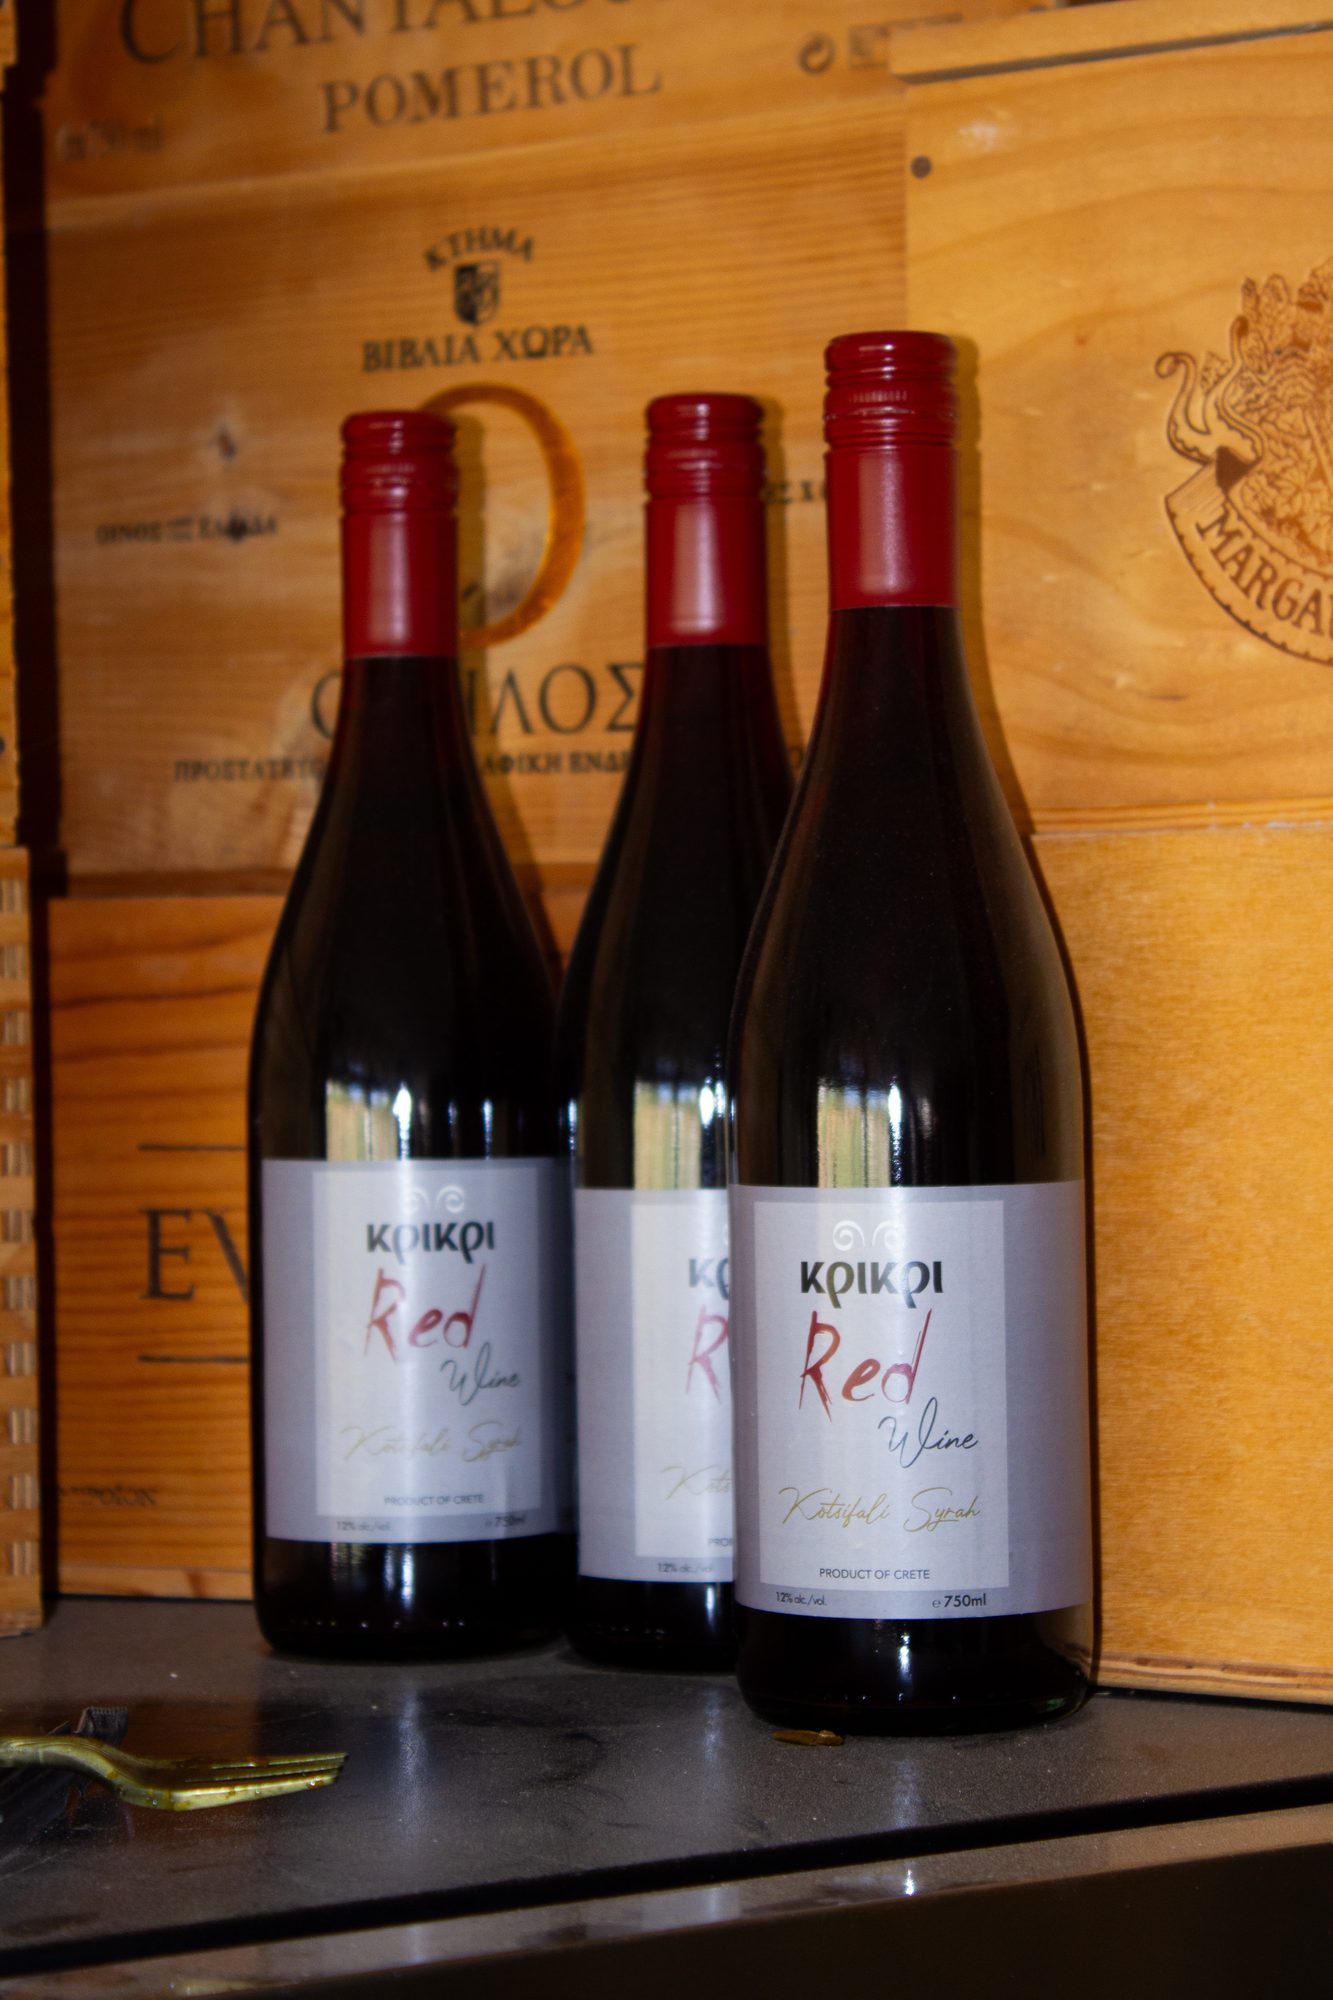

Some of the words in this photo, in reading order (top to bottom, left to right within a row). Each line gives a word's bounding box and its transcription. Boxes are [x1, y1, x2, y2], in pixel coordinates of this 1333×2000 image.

[319, 45, 662, 133] POMEROL
[423, 226, 534, 272] ΚΤΗΜΑ
[493, 324, 593, 362] ΧΩΡΑ
[1195, 501, 1333, 640] MARGA
[363, 1265, 486, 1363] Red
[440, 1342, 520, 1406] Wine
[799, 1308, 932, 1423] Red
[877, 1397, 978, 1468] Wine
[778, 1487, 890, 1528] Kotsifali
[903, 1487, 980, 1532] Syrah
[819, 1568, 871, 1579] PRODUCT
[874, 1569, 890, 1580] OF
[893, 1570, 930, 1580] CRETE
[944, 1593, 987, 1607] 750ml
